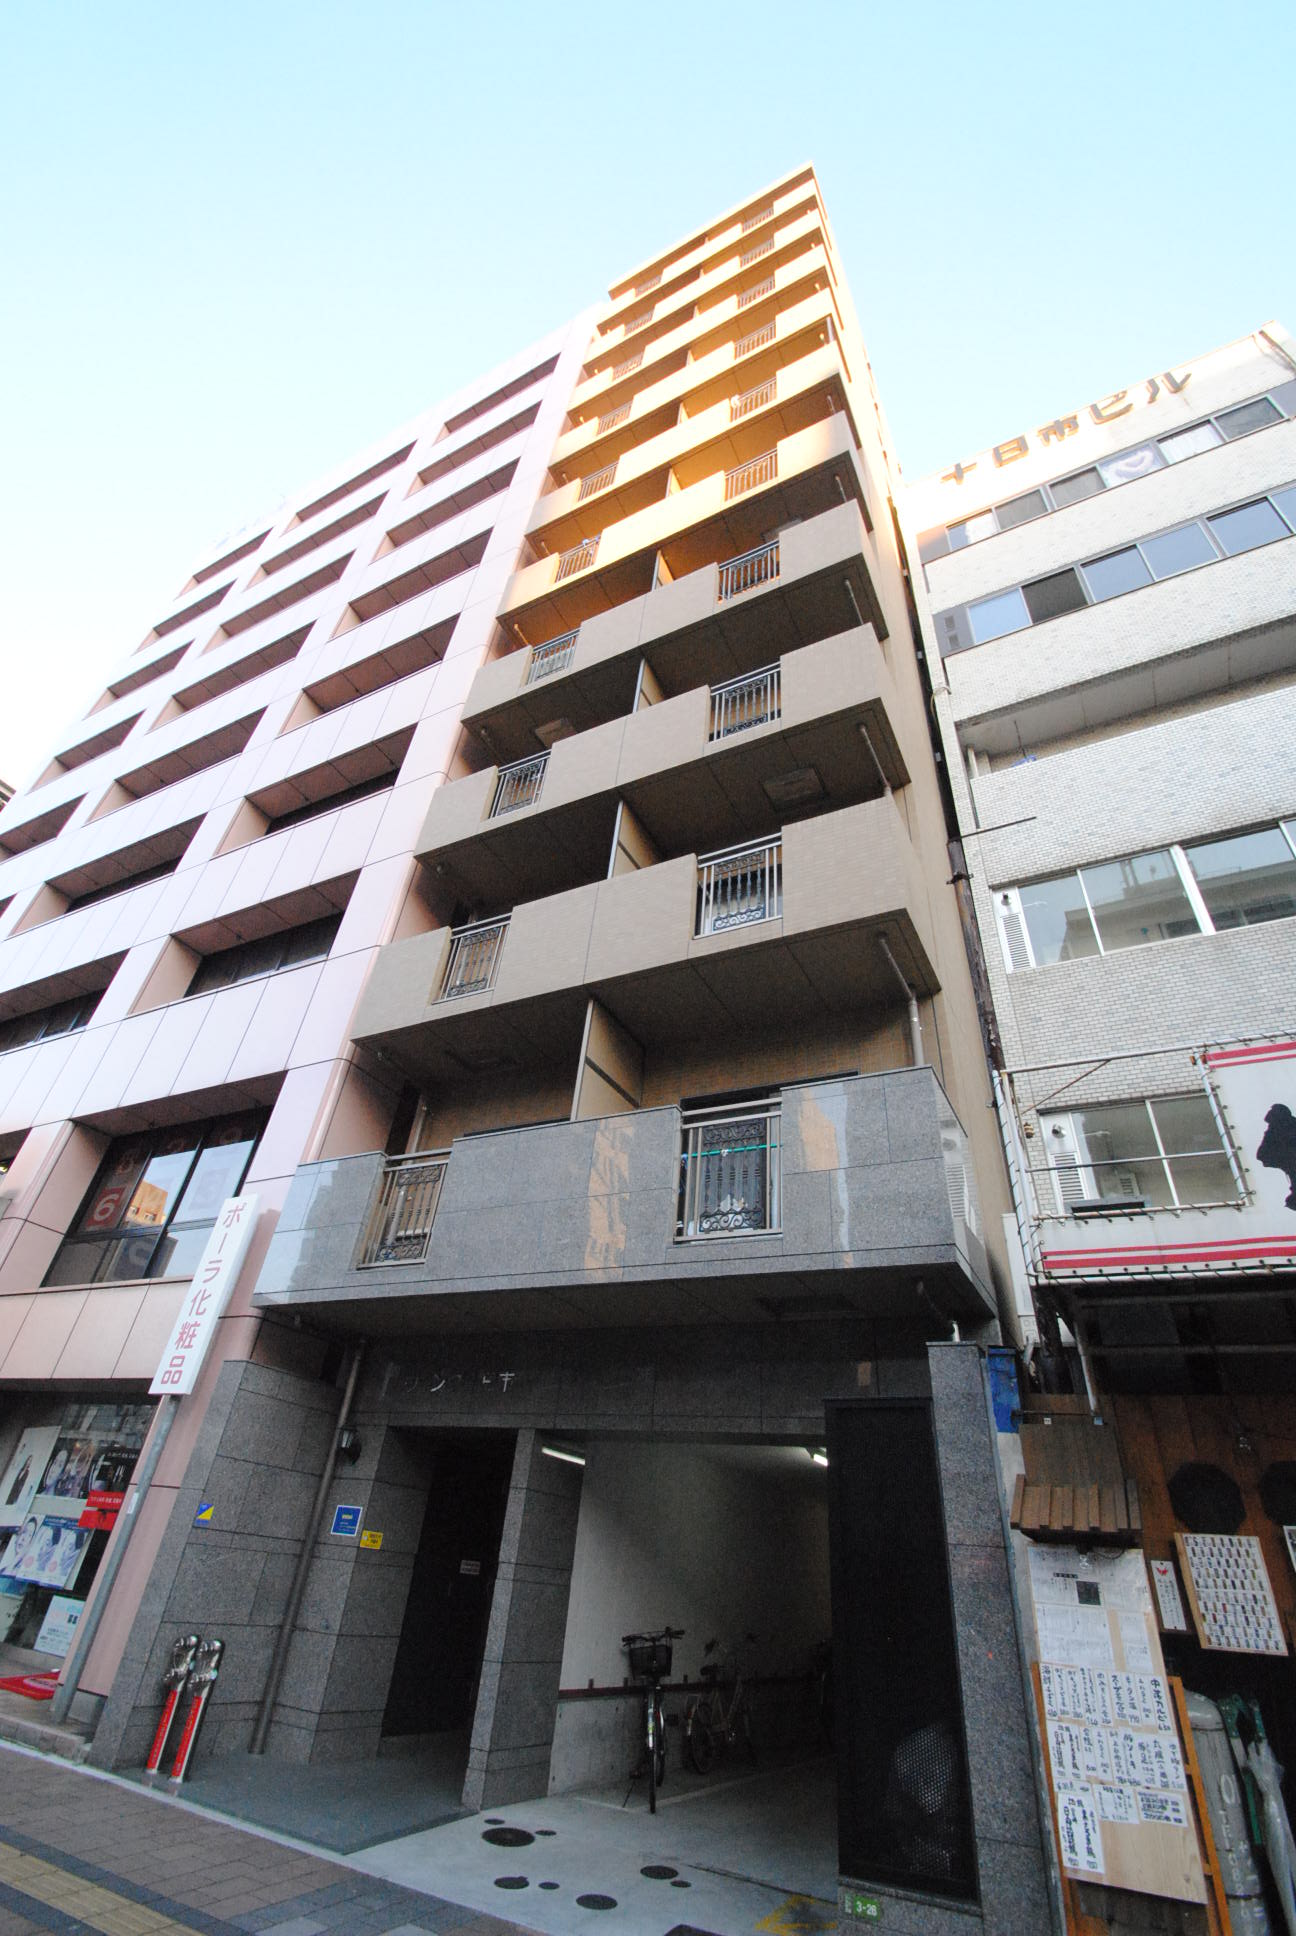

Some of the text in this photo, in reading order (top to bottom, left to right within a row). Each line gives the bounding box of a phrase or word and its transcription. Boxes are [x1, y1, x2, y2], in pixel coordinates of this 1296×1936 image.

[941, 371, 1193, 485] 十日市ビル
[160, 1202, 248, 1385] ポーラ化粧品
